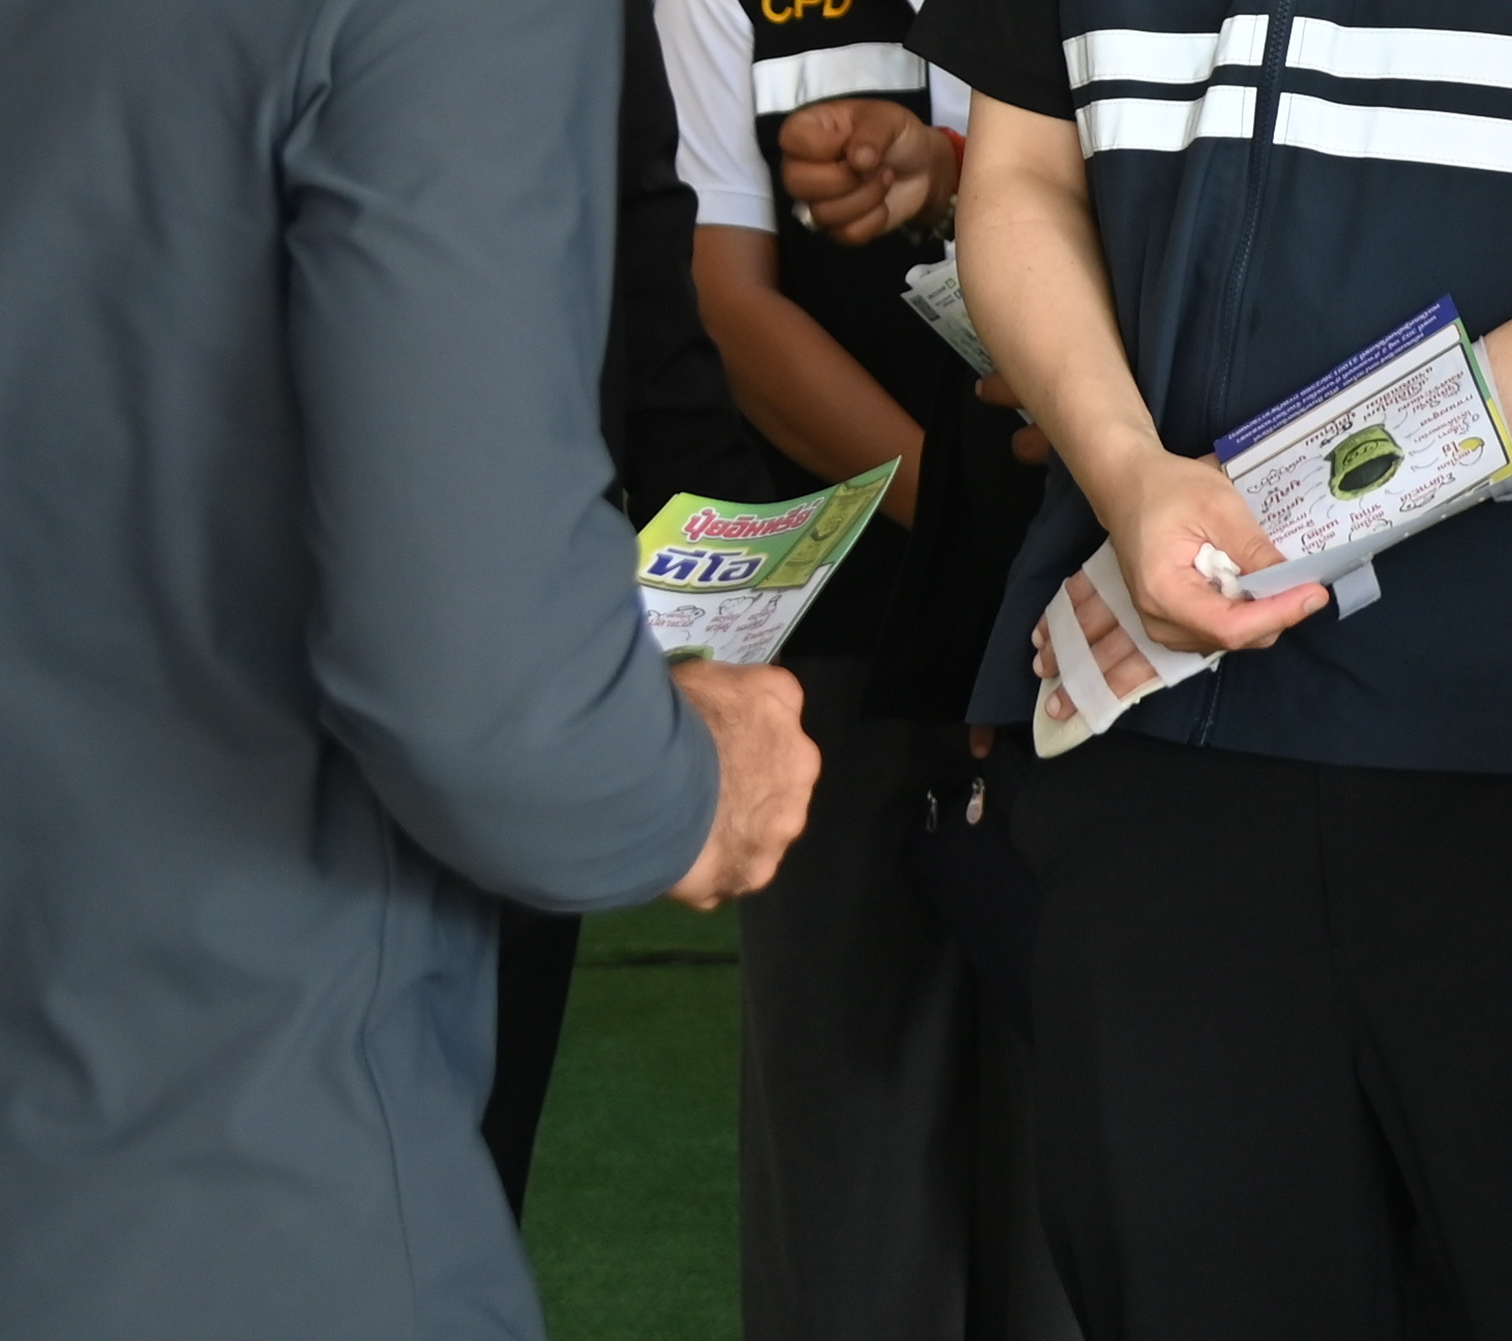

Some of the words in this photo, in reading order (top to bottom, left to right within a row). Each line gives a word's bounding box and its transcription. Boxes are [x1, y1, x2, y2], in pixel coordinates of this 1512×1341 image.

[681, 496, 825, 544] ปุ๋ยอินทรีย์
[646, 546, 766, 583] ทีโอ
